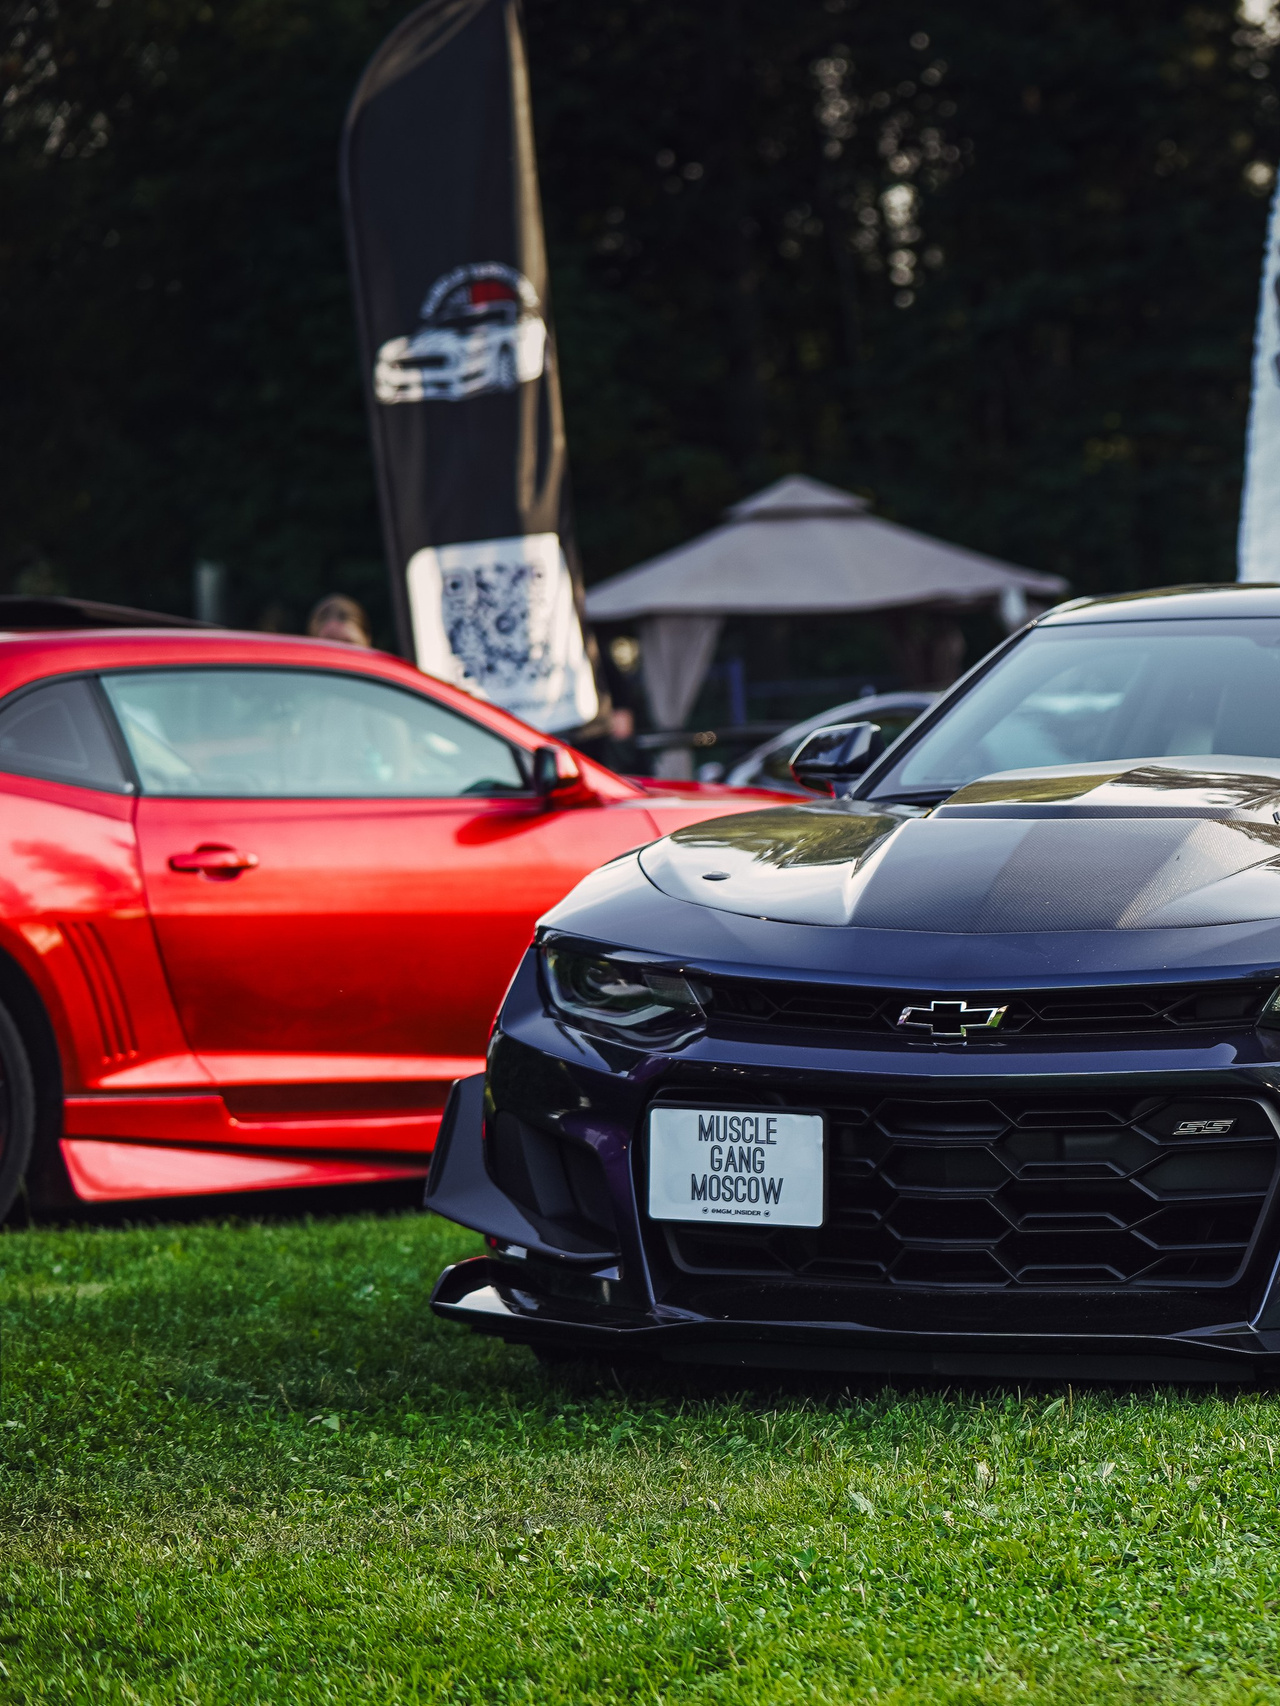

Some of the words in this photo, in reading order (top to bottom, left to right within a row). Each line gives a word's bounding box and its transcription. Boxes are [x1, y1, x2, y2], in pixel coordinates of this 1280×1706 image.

[698, 1114, 777, 1144] MUSCLE
[1172, 1119, 1235, 1136] SS
[710, 1145, 765, 1173] GANG
[691, 1174, 783, 1204] MOSCOW
